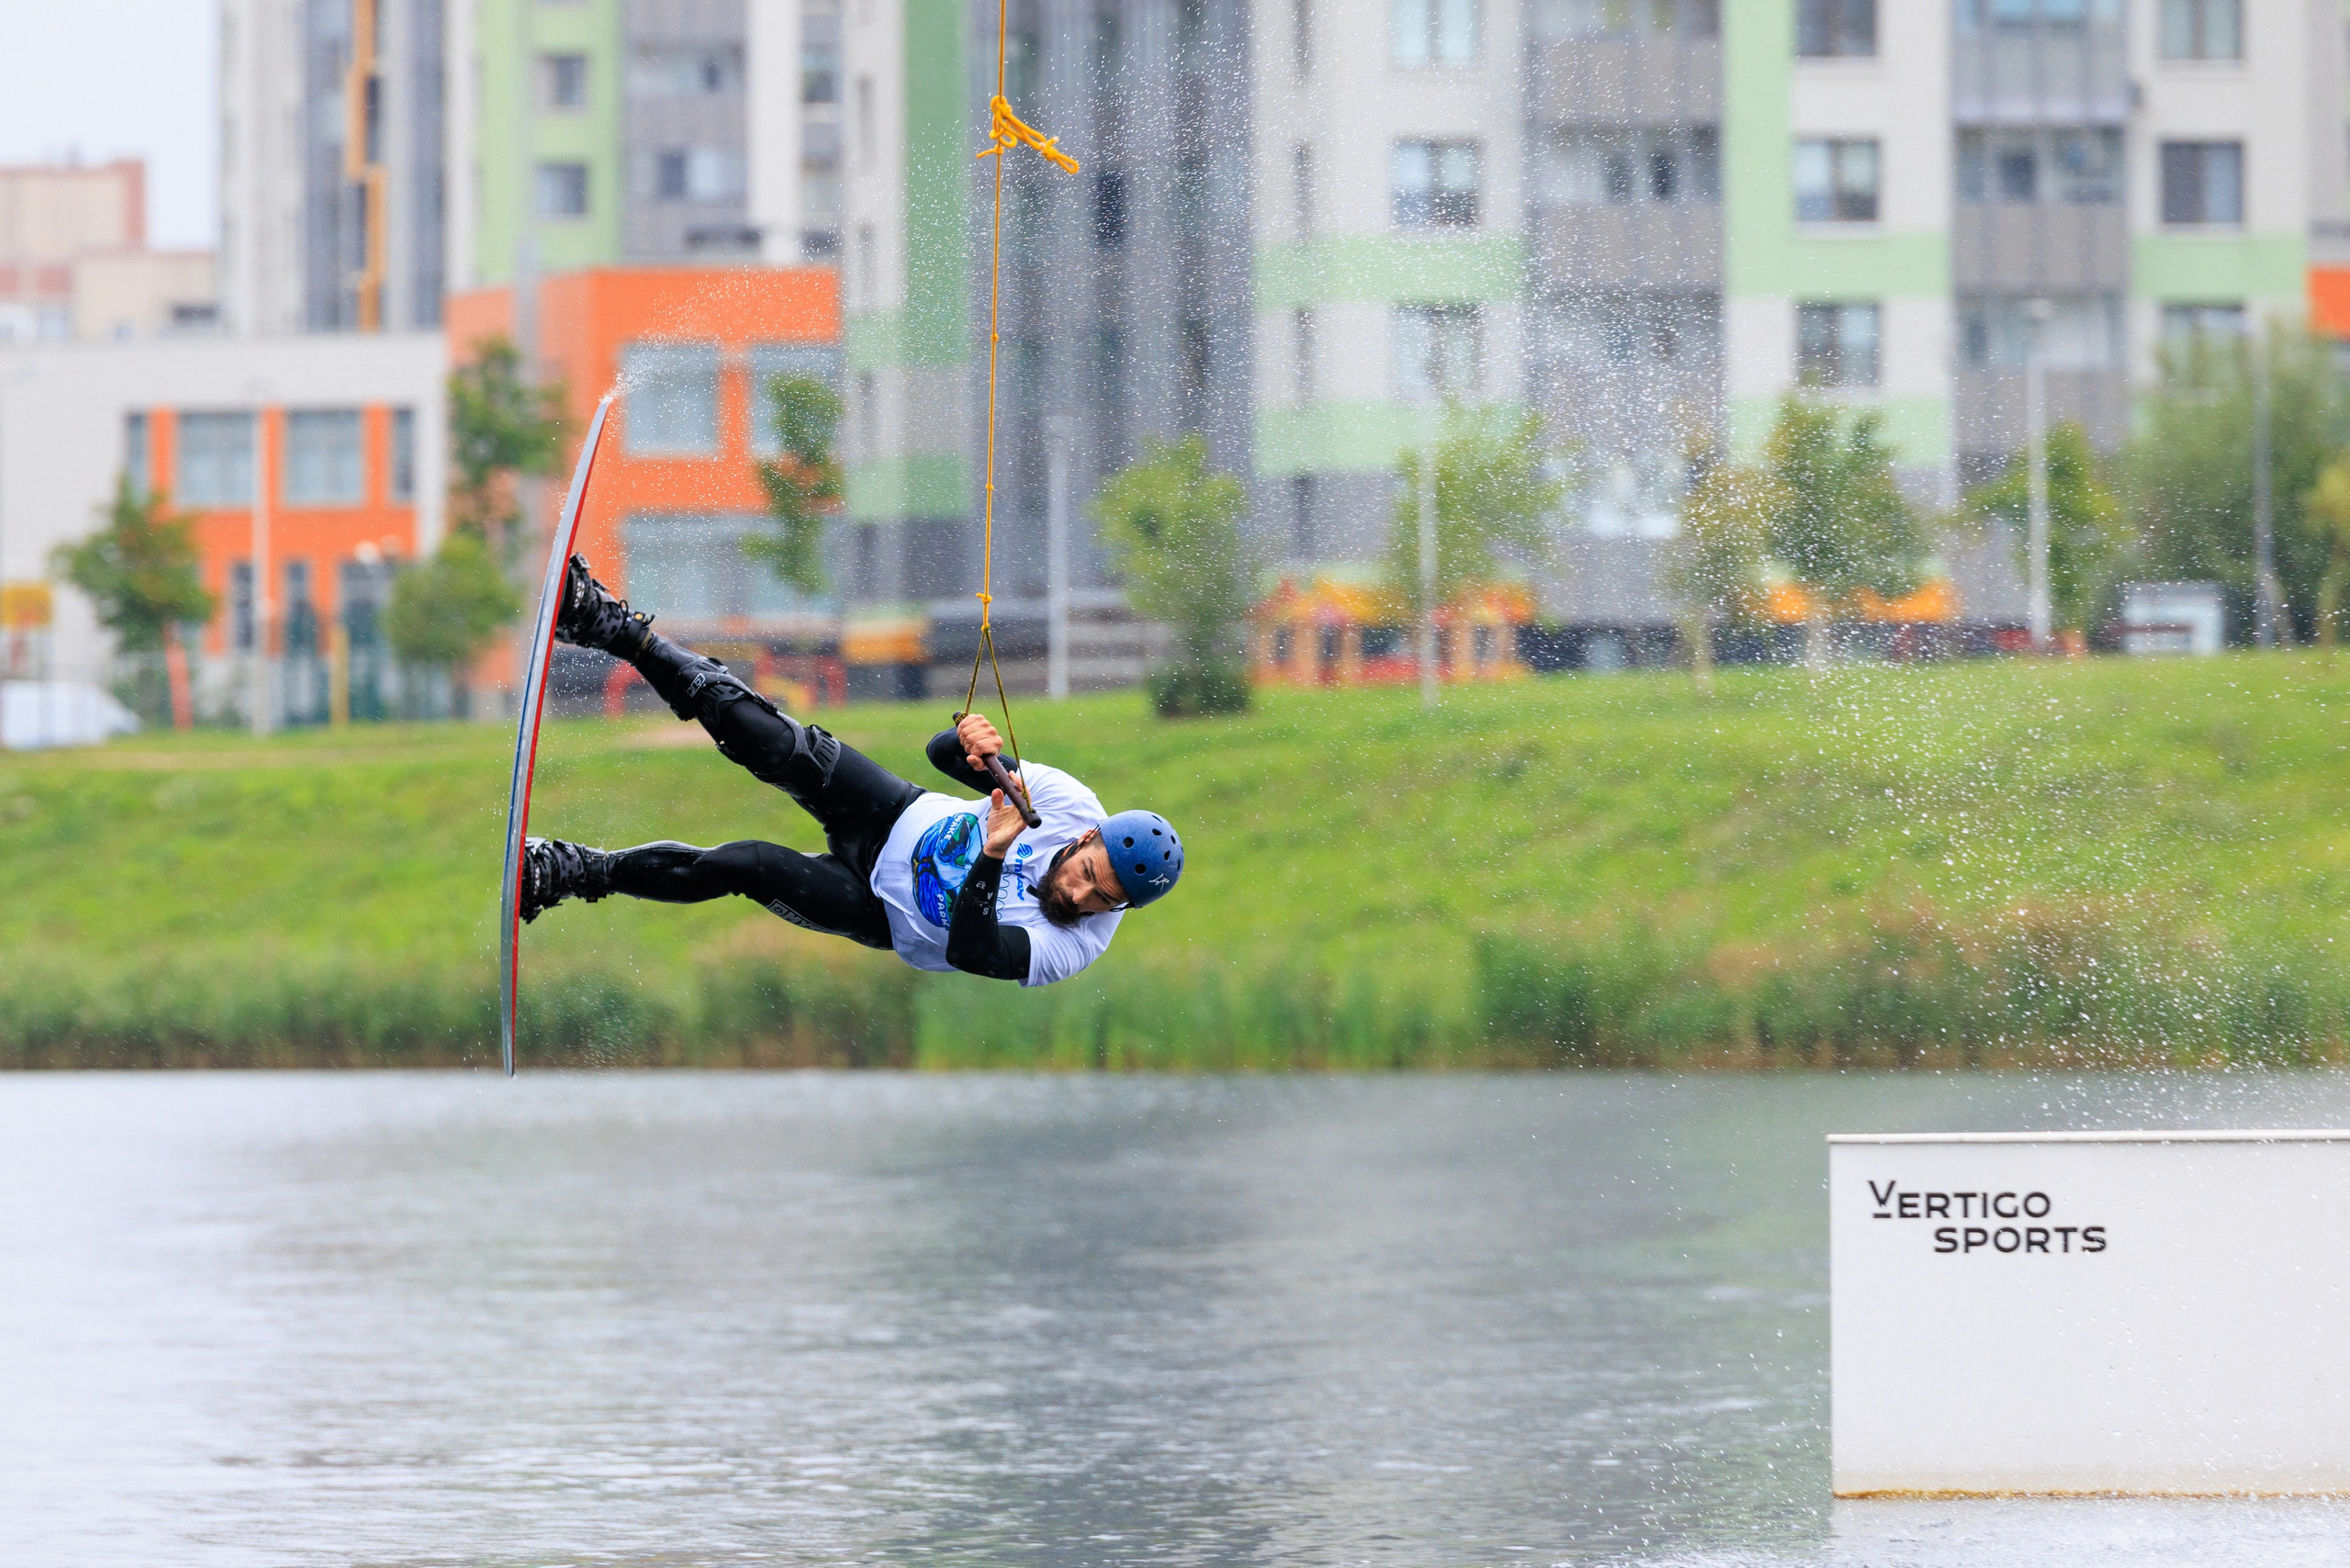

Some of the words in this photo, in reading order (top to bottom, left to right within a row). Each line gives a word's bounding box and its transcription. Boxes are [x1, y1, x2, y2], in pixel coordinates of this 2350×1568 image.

[944, 814, 966, 841] WAKE
[936, 893, 951, 927] PARK
[1867, 1180, 2052, 1219] VERTIGO
[1933, 1226, 2108, 1254] SPORTS
